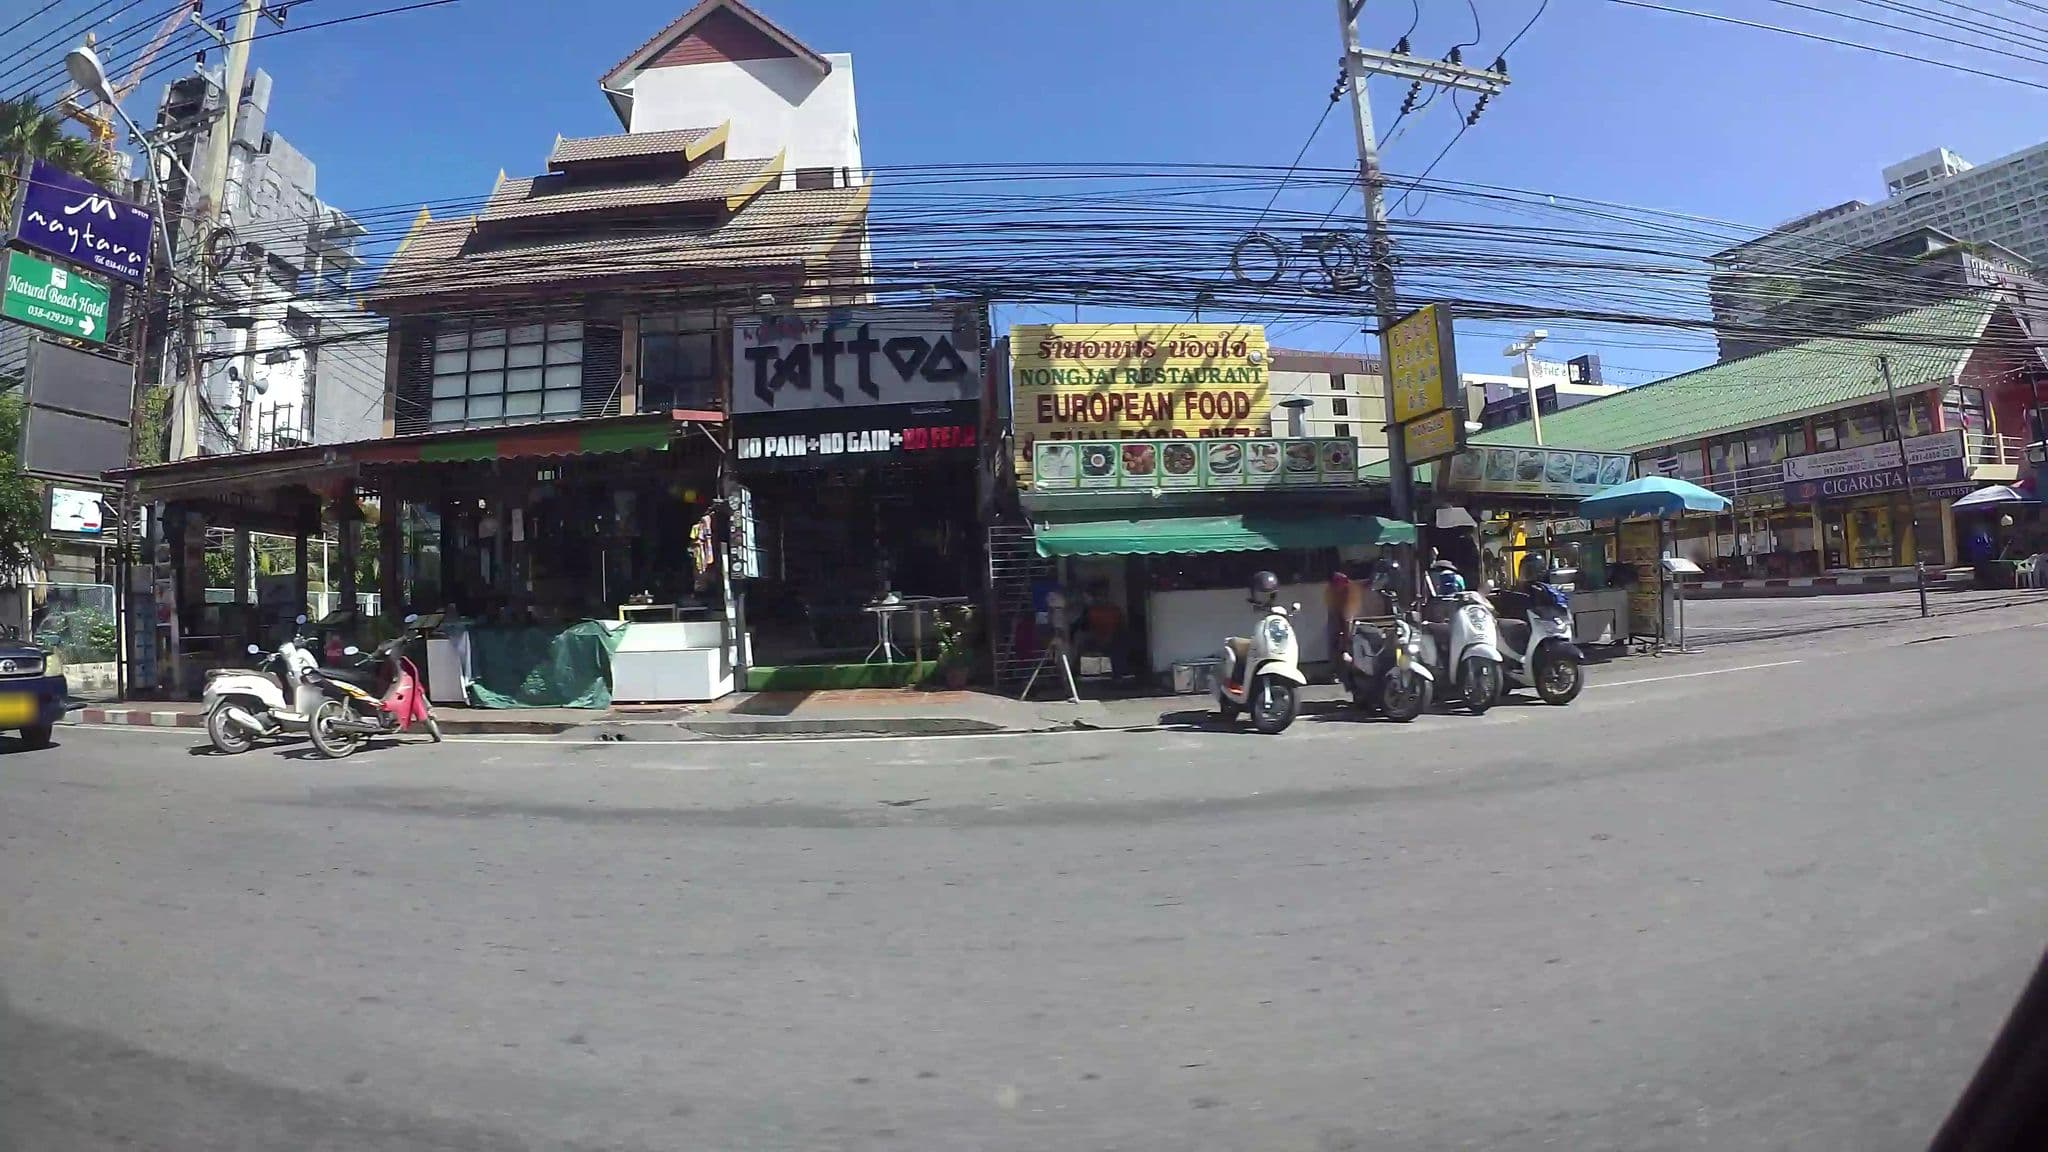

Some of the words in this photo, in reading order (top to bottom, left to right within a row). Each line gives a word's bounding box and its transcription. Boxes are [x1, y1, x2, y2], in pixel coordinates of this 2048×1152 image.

[27, 211, 142, 263] maytara
[7, 275, 50, 301] Natural
[48, 287, 79, 309] Beach
[78, 296, 106, 318] Hotel
[27, 305, 74, 326] 038-429239
[1039, 333, 1157, 359] ร้านอาหาร
[1020, 368, 1117, 386] NONGJAI
[1126, 367, 1263, 386] RESTAURANT
[1037, 391, 1175, 424] EUROPEAN
[1184, 390, 1252, 421] FOOD
[1822, 472, 1904, 495] CIGARISTA
